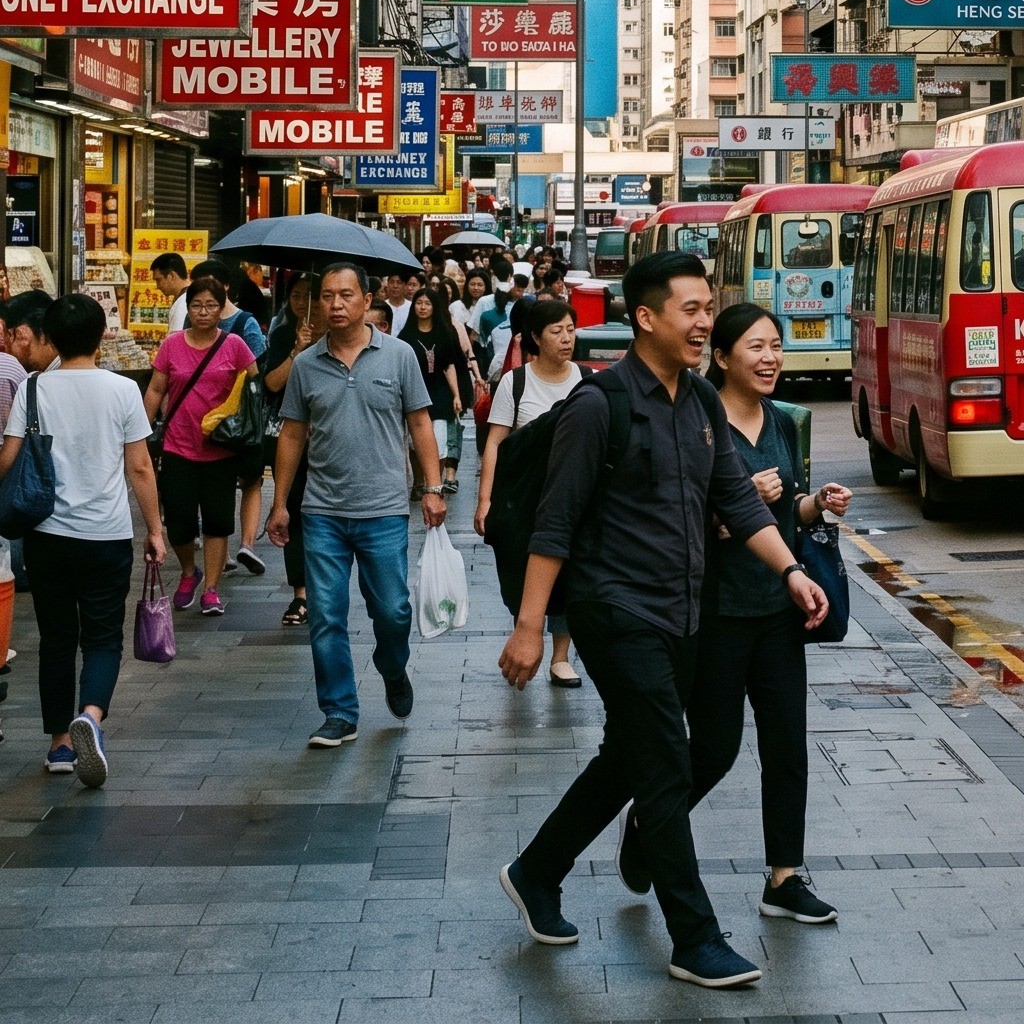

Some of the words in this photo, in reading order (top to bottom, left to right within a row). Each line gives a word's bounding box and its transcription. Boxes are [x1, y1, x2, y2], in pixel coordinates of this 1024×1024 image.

[957, 5, 1002, 19] HENG
[172, 27, 342, 59] JEWELLERY
[172, 66, 335, 96] MOBILE
[259, 119, 384, 144] MOBILE
